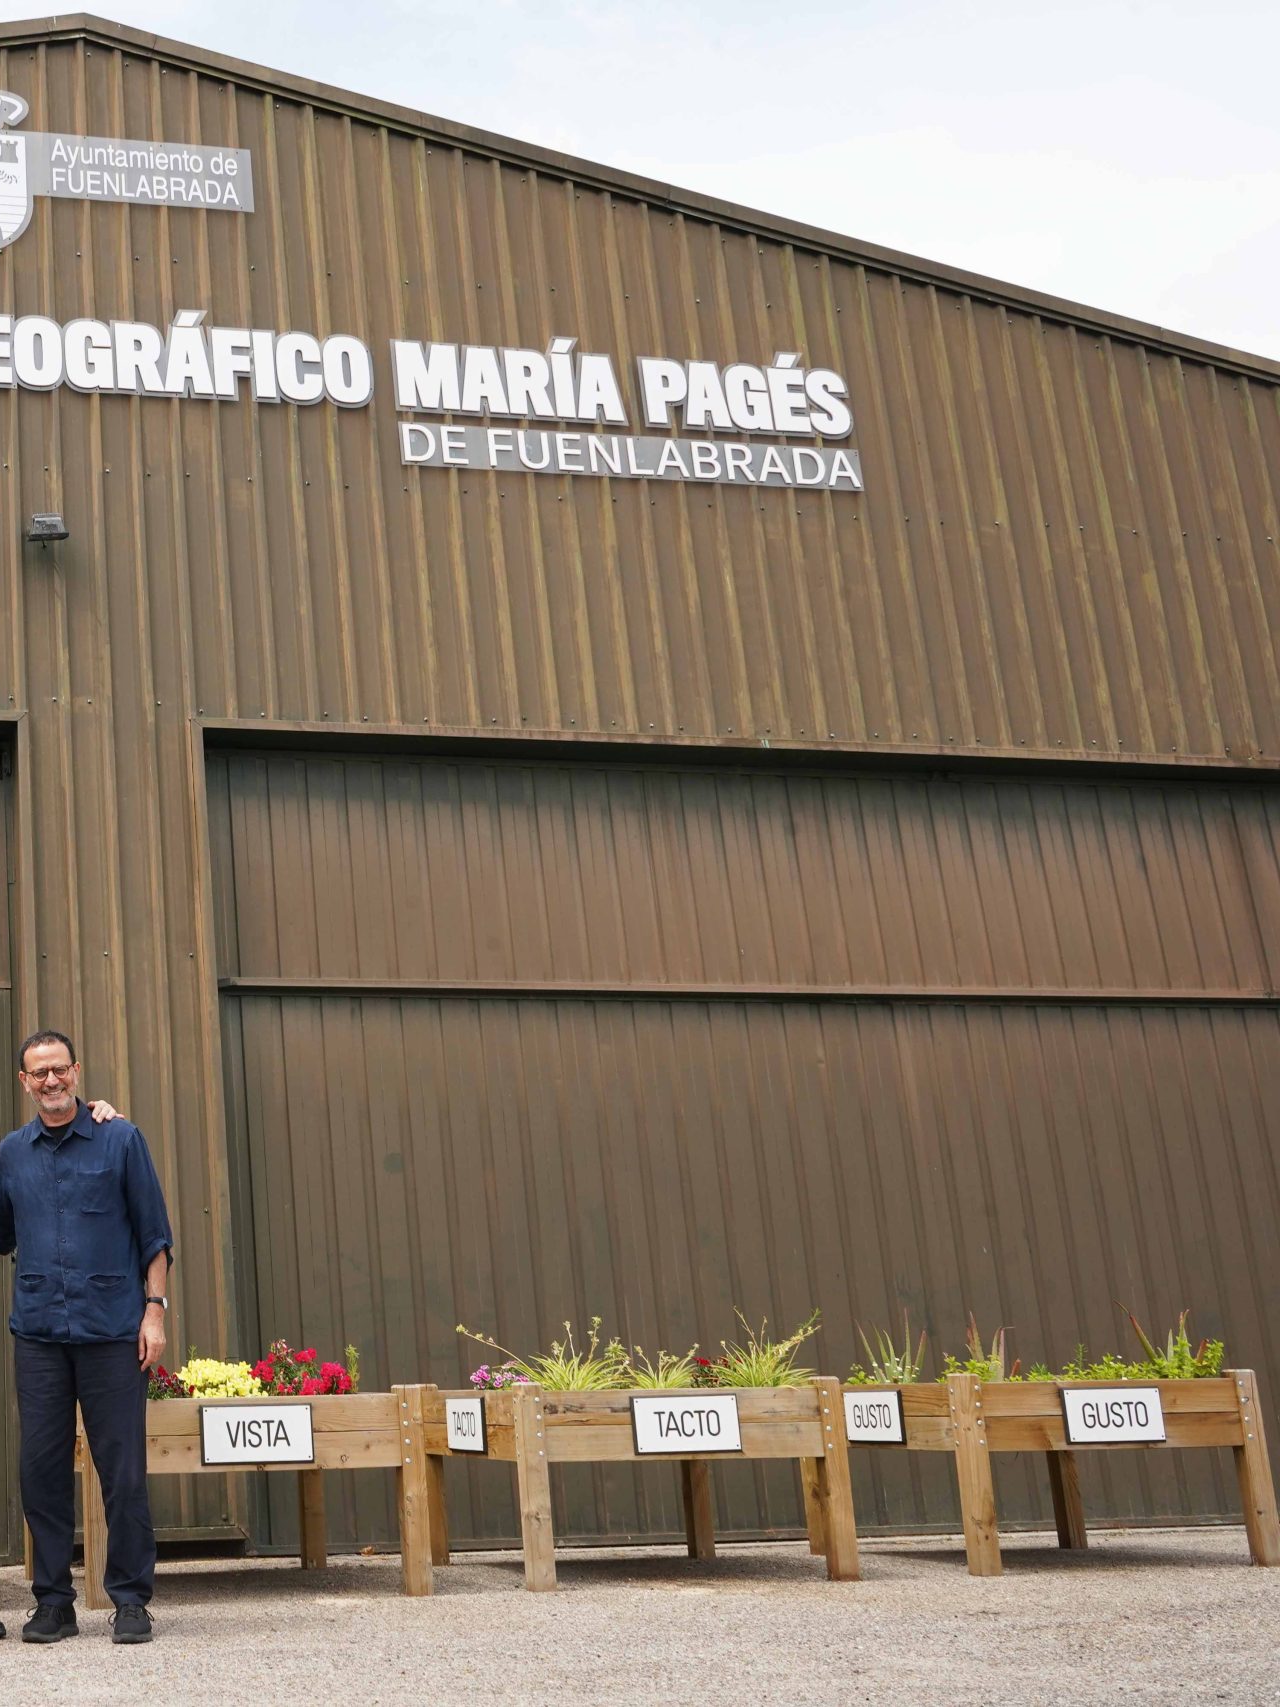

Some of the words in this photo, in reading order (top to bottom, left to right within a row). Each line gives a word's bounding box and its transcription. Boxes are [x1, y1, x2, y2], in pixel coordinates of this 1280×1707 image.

[50, 138, 204, 173] Ayuntamiento
[210, 150, 238, 176] de
[51, 168, 240, 206] FUENLABRADA
[394, 338, 625, 422] MARÍA
[641, 354, 852, 437] PAGÉS
[401, 423, 470, 465] DE
[487, 429, 862, 489] FUENLABRADA
[452, 1411, 476, 1437] TACTO
[653, 1409, 721, 1437] TACTO
[852, 1403, 892, 1429] GUSTO
[1081, 1401, 1149, 1429] GUSTO
[225, 1419, 291, 1448] VISTA
